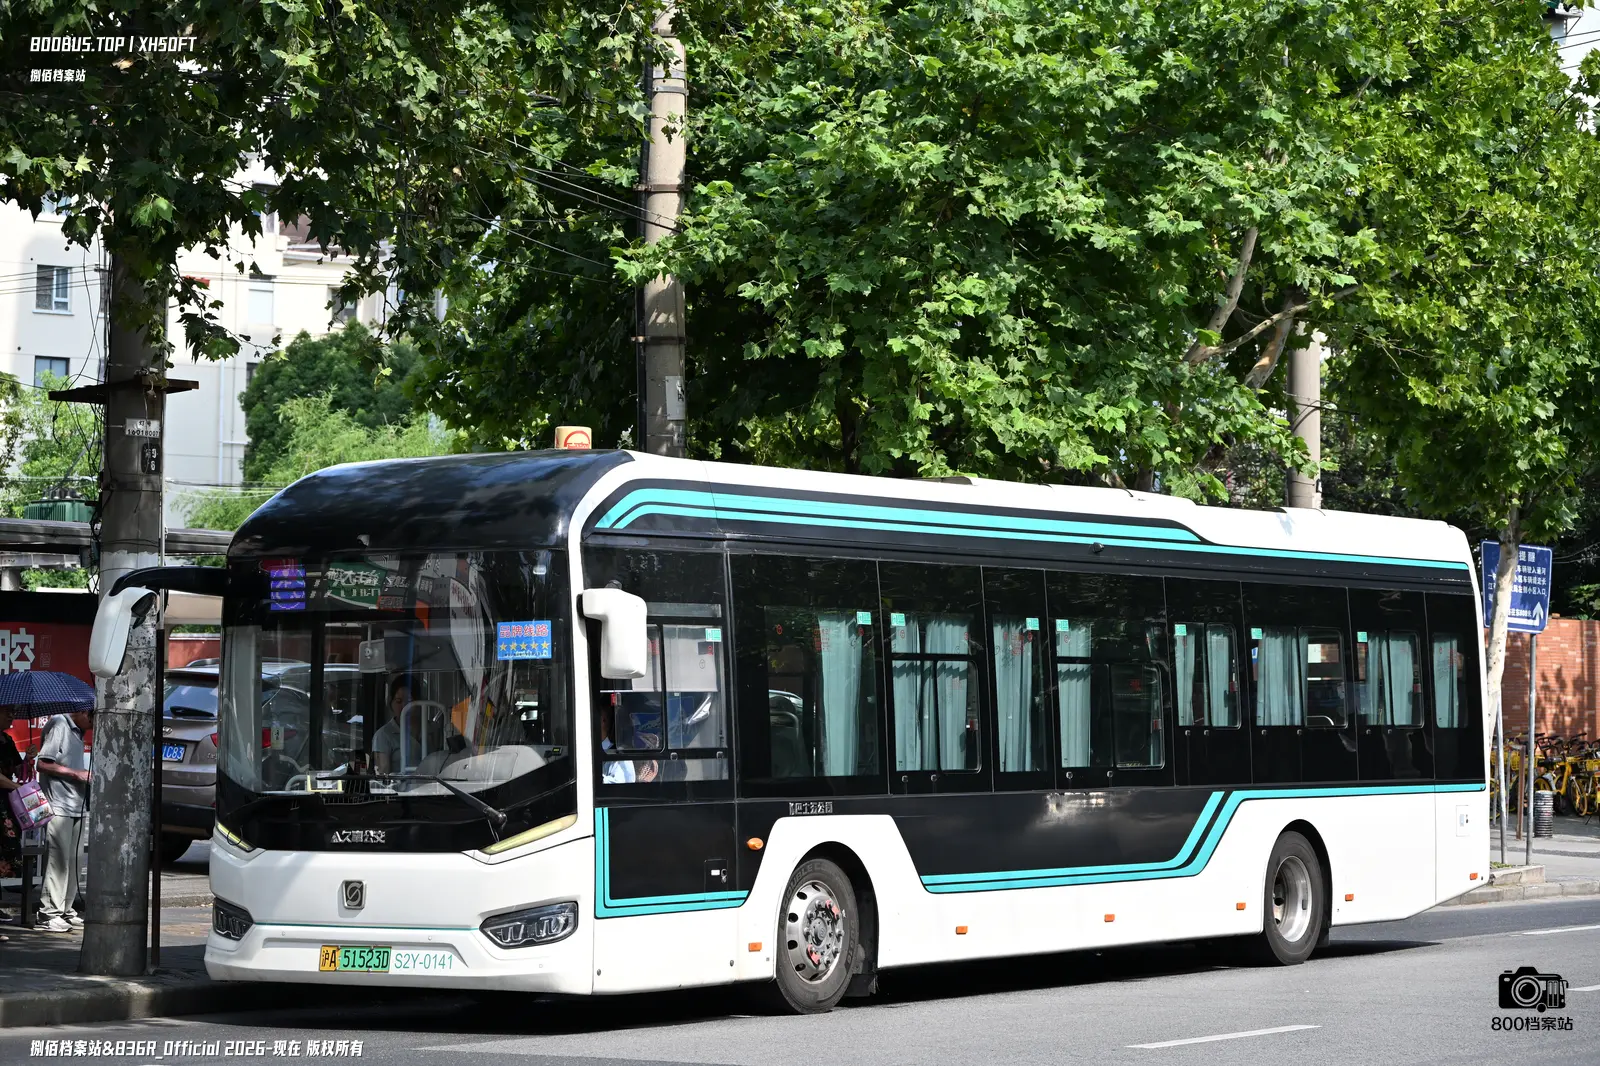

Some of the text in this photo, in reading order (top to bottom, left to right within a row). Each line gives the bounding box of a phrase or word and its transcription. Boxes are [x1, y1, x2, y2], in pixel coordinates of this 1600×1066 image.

[499, 624, 549, 638] 品牌线路
[394, 953, 453, 969] S2Y-0141
